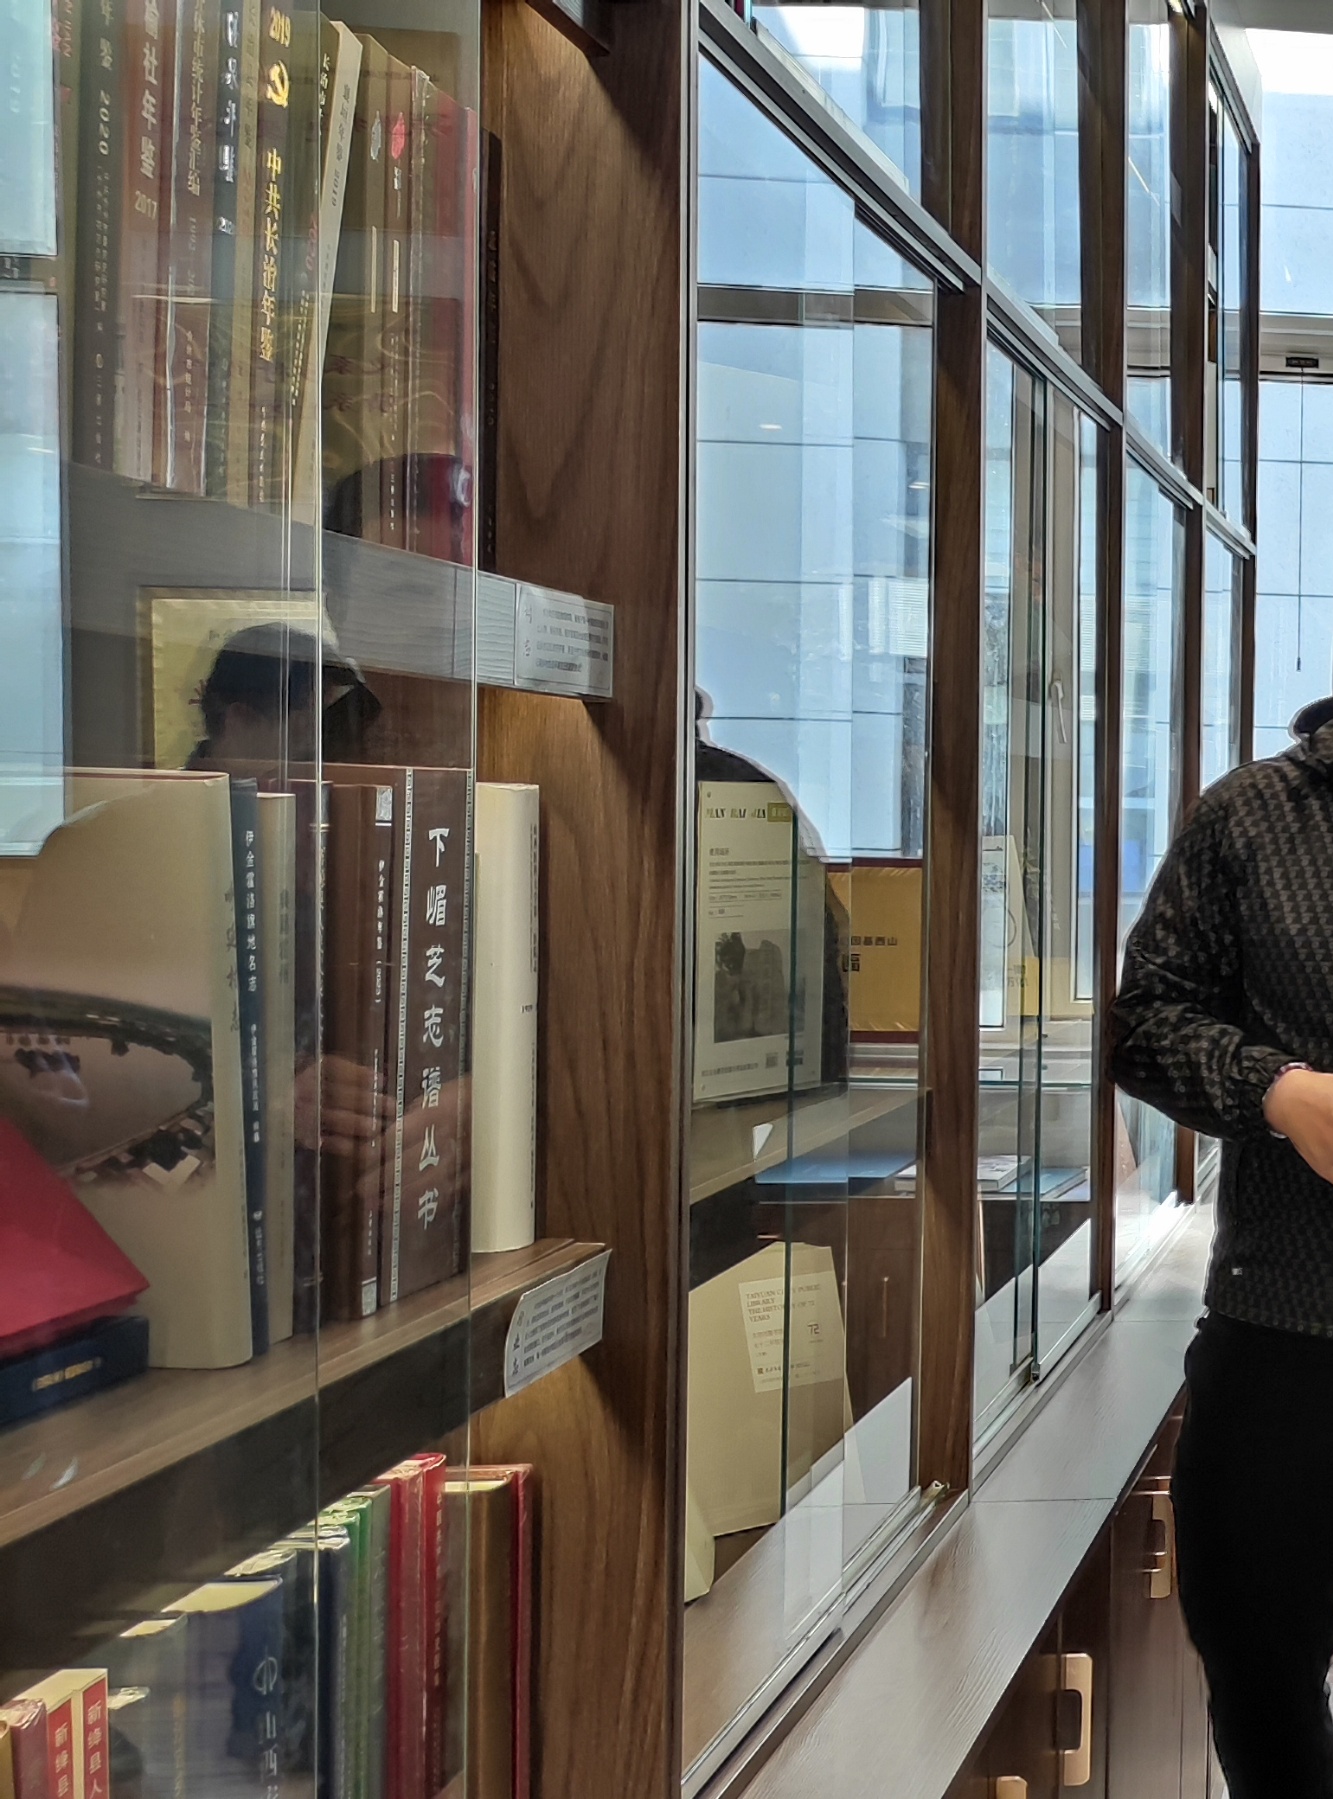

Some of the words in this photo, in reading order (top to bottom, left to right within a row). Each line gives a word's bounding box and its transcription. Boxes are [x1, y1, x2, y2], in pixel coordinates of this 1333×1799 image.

[269, 6, 292, 47] 2019
[259, 148, 282, 363] 中共长治年鉴
